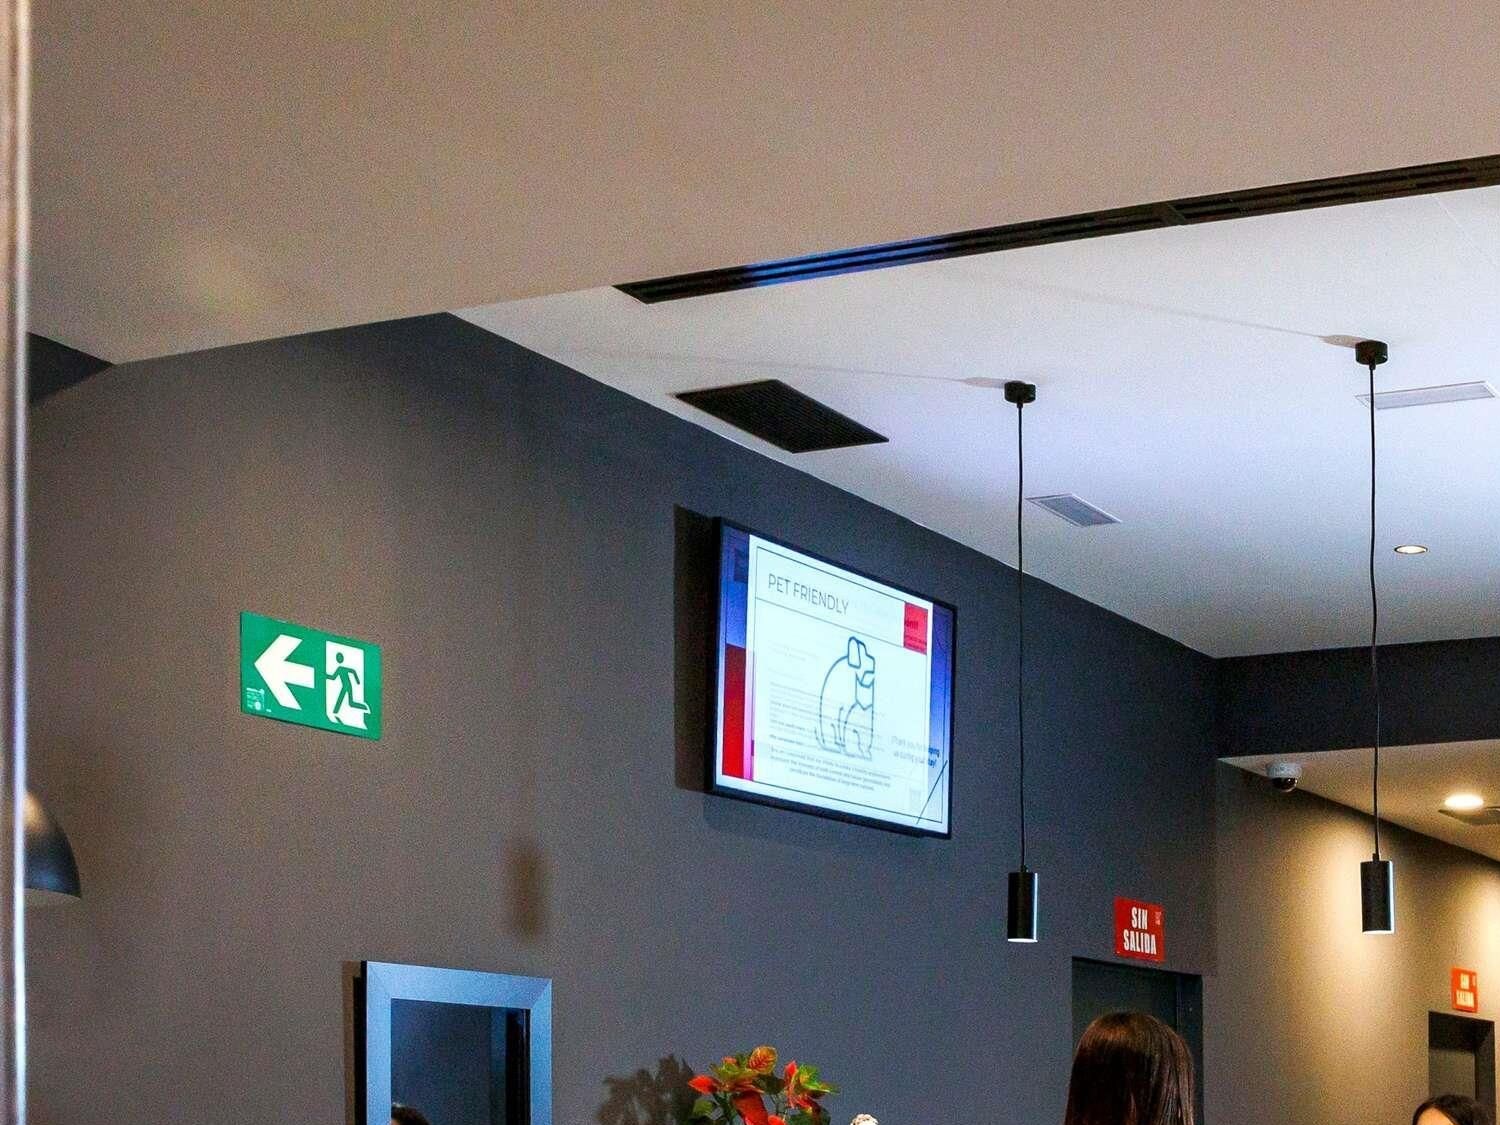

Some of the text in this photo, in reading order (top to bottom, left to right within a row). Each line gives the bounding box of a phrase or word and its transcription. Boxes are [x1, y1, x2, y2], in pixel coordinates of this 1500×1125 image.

[768, 573, 849, 616] PET FRIENDLY
[1131, 906, 1148, 930] SIN
[1123, 928, 1157, 955] SALIDA
